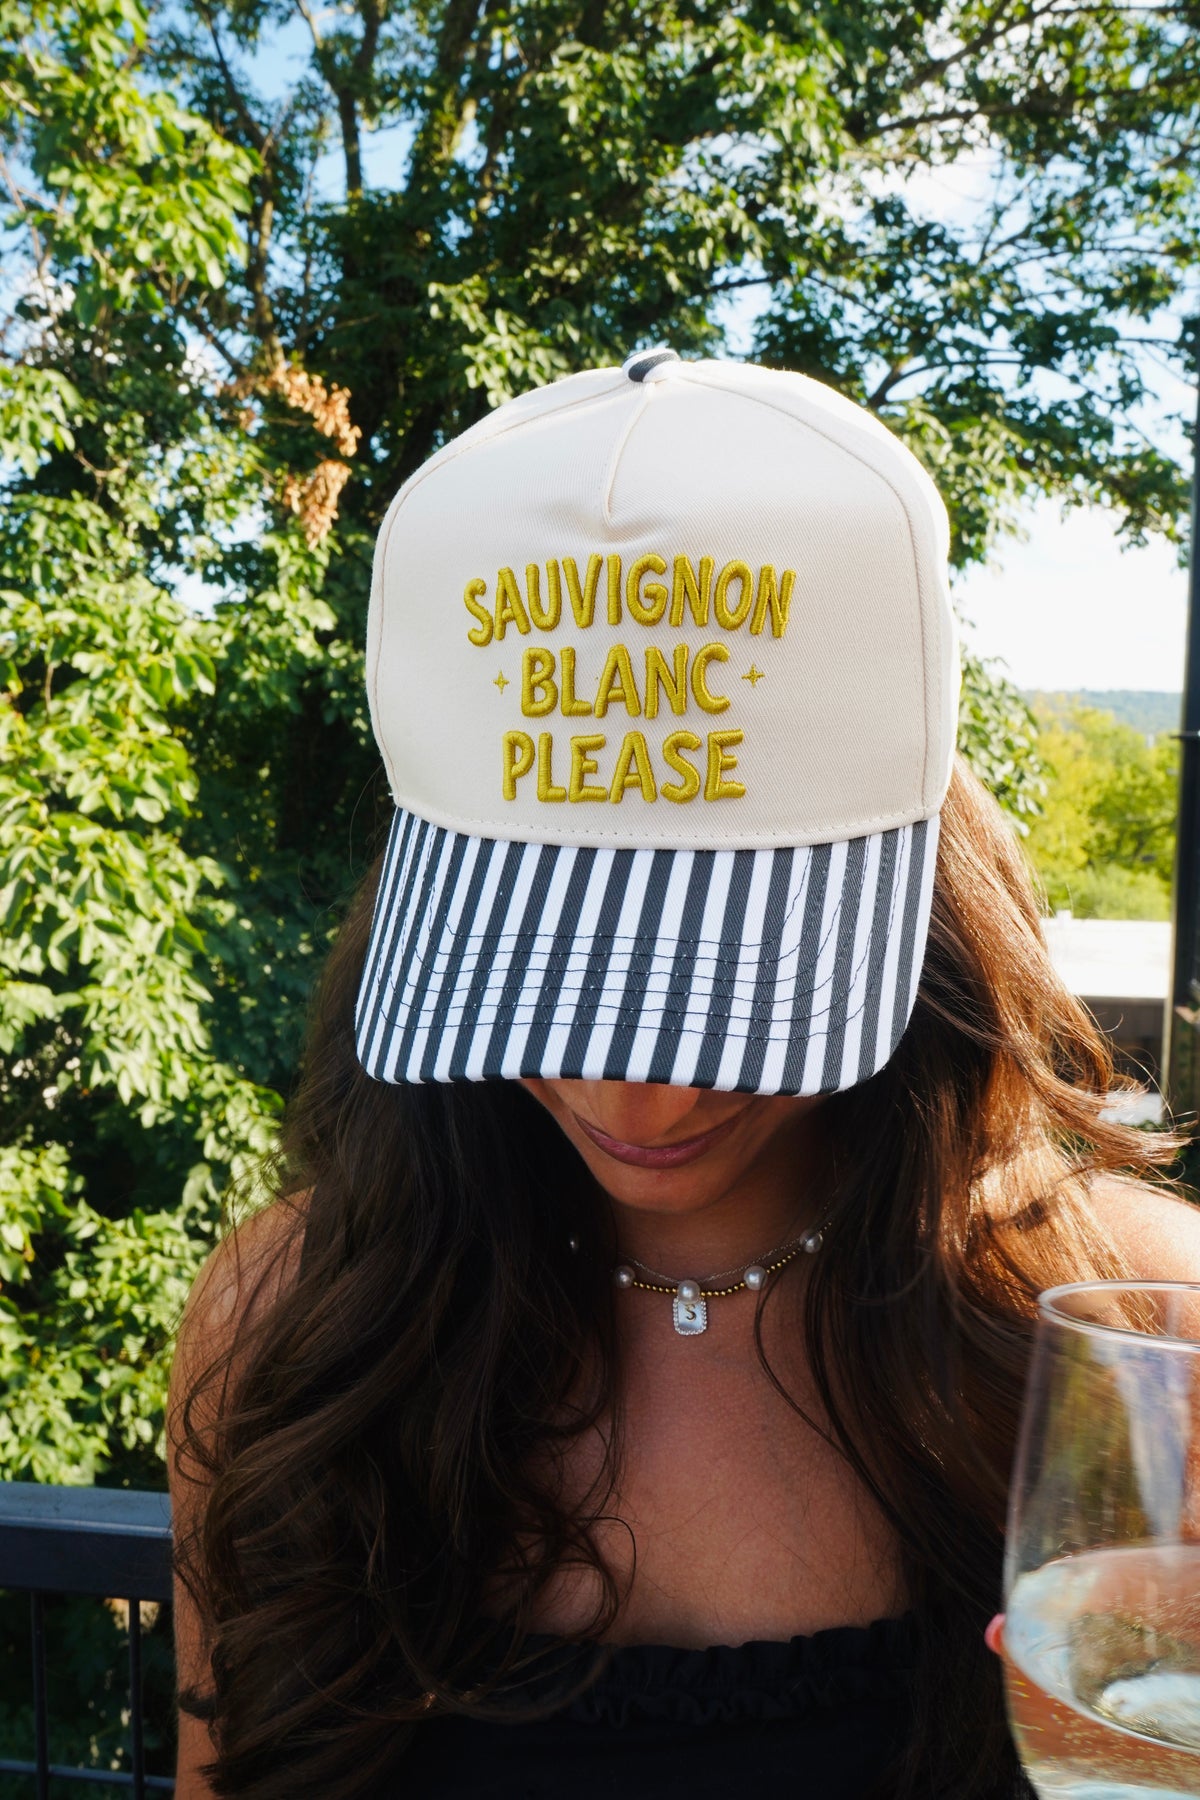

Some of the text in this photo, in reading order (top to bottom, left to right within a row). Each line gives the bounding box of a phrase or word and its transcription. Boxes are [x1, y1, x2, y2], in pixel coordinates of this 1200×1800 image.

[464, 553, 796, 647] SAUVIGNON
[521, 642, 731, 718] BLANC
[503, 729, 746, 804] PLEASE
